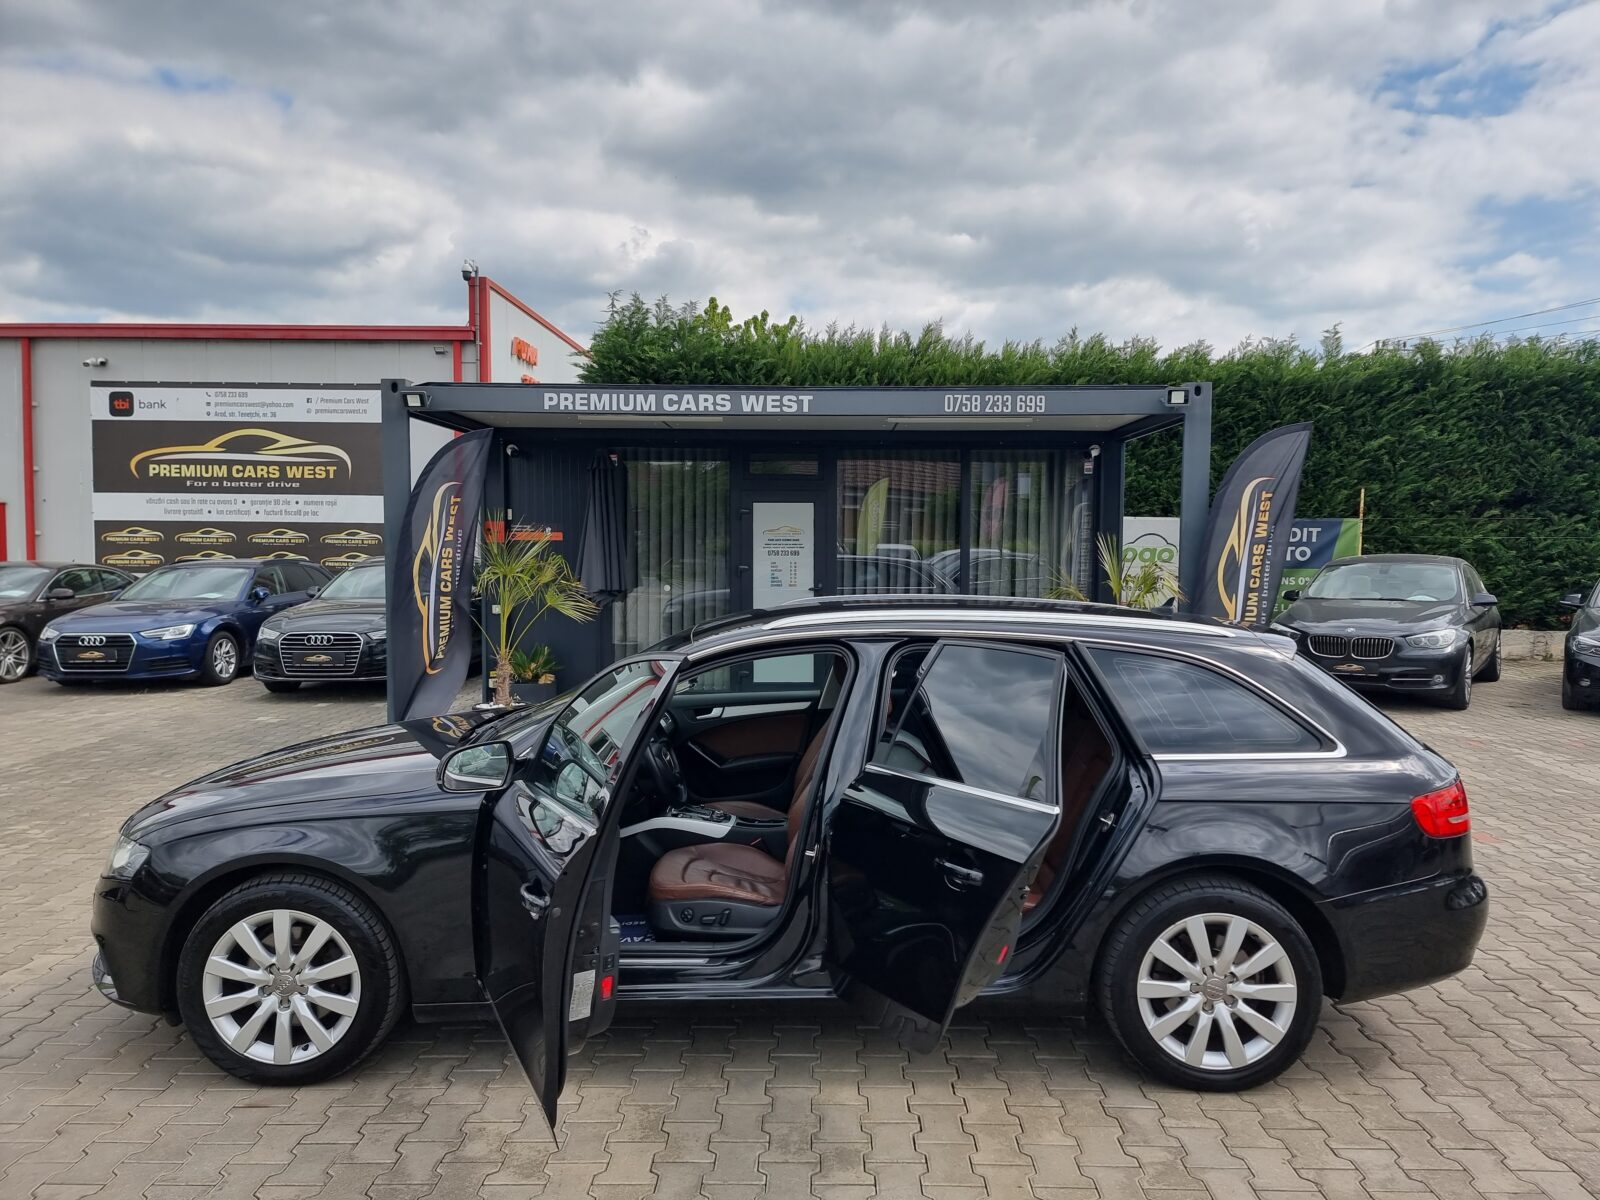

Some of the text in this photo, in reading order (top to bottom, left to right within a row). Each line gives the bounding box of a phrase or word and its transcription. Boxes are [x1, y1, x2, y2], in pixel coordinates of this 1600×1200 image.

[114, 399, 167, 409] tbi bank
[543, 392, 813, 412] PREMIUM CARS WEST
[944, 394, 1045, 413] 0758 233 699
[149, 464, 336, 479] PREMIUM CARS WEST
[1254, 491, 1274, 538] WEST
[435, 495, 462, 660] PREMIUM CARS WEST
[1249, 544, 1266, 588] CARS
[1262, 559, 1271, 597] better
